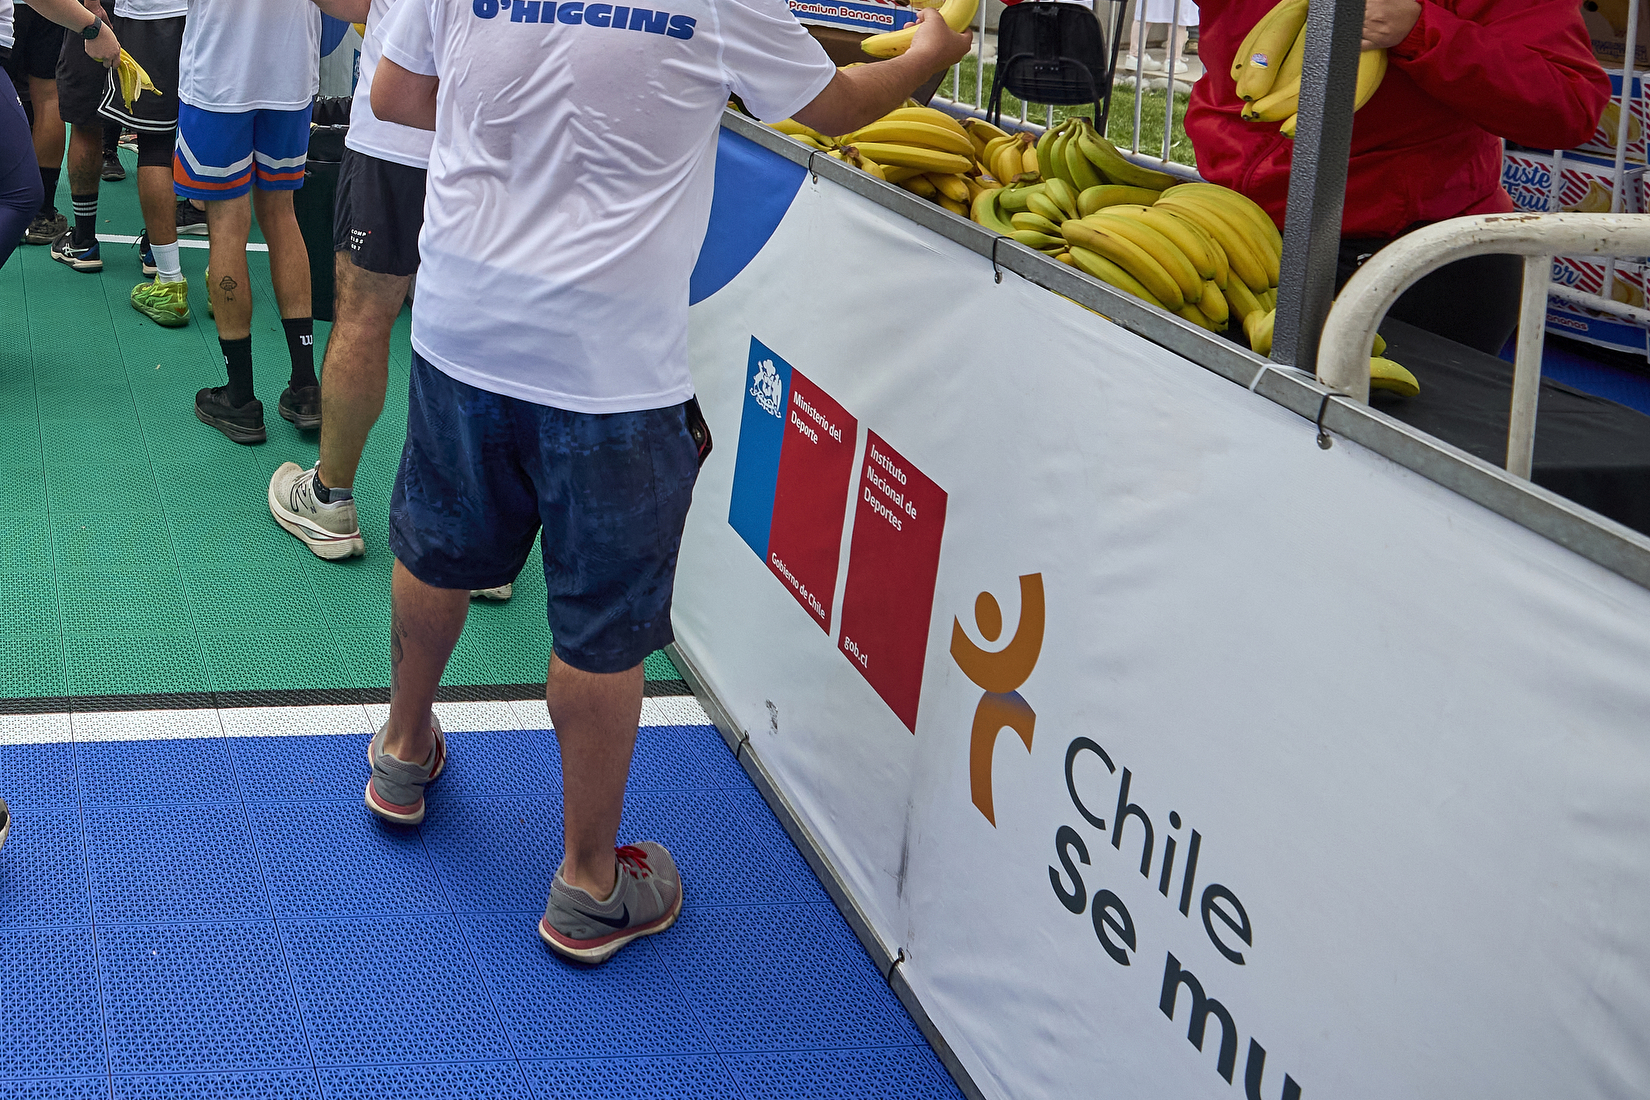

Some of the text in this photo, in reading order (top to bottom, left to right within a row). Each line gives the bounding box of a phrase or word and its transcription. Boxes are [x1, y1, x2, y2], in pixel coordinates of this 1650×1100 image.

[789, 0, 894, 25] Premium Bananas
[791, 410, 819, 445] Deporte
[792, 390, 842, 443] Ministerio del
[870, 443, 907, 486] Instituto
[863, 486, 903, 532] Deportes
[866, 465, 917, 520] Nacional de
[771, 552, 826, 620] Gobierno de Chile
[844, 635, 868, 669] gob.cl
[1064, 736, 1252, 966] Chile
